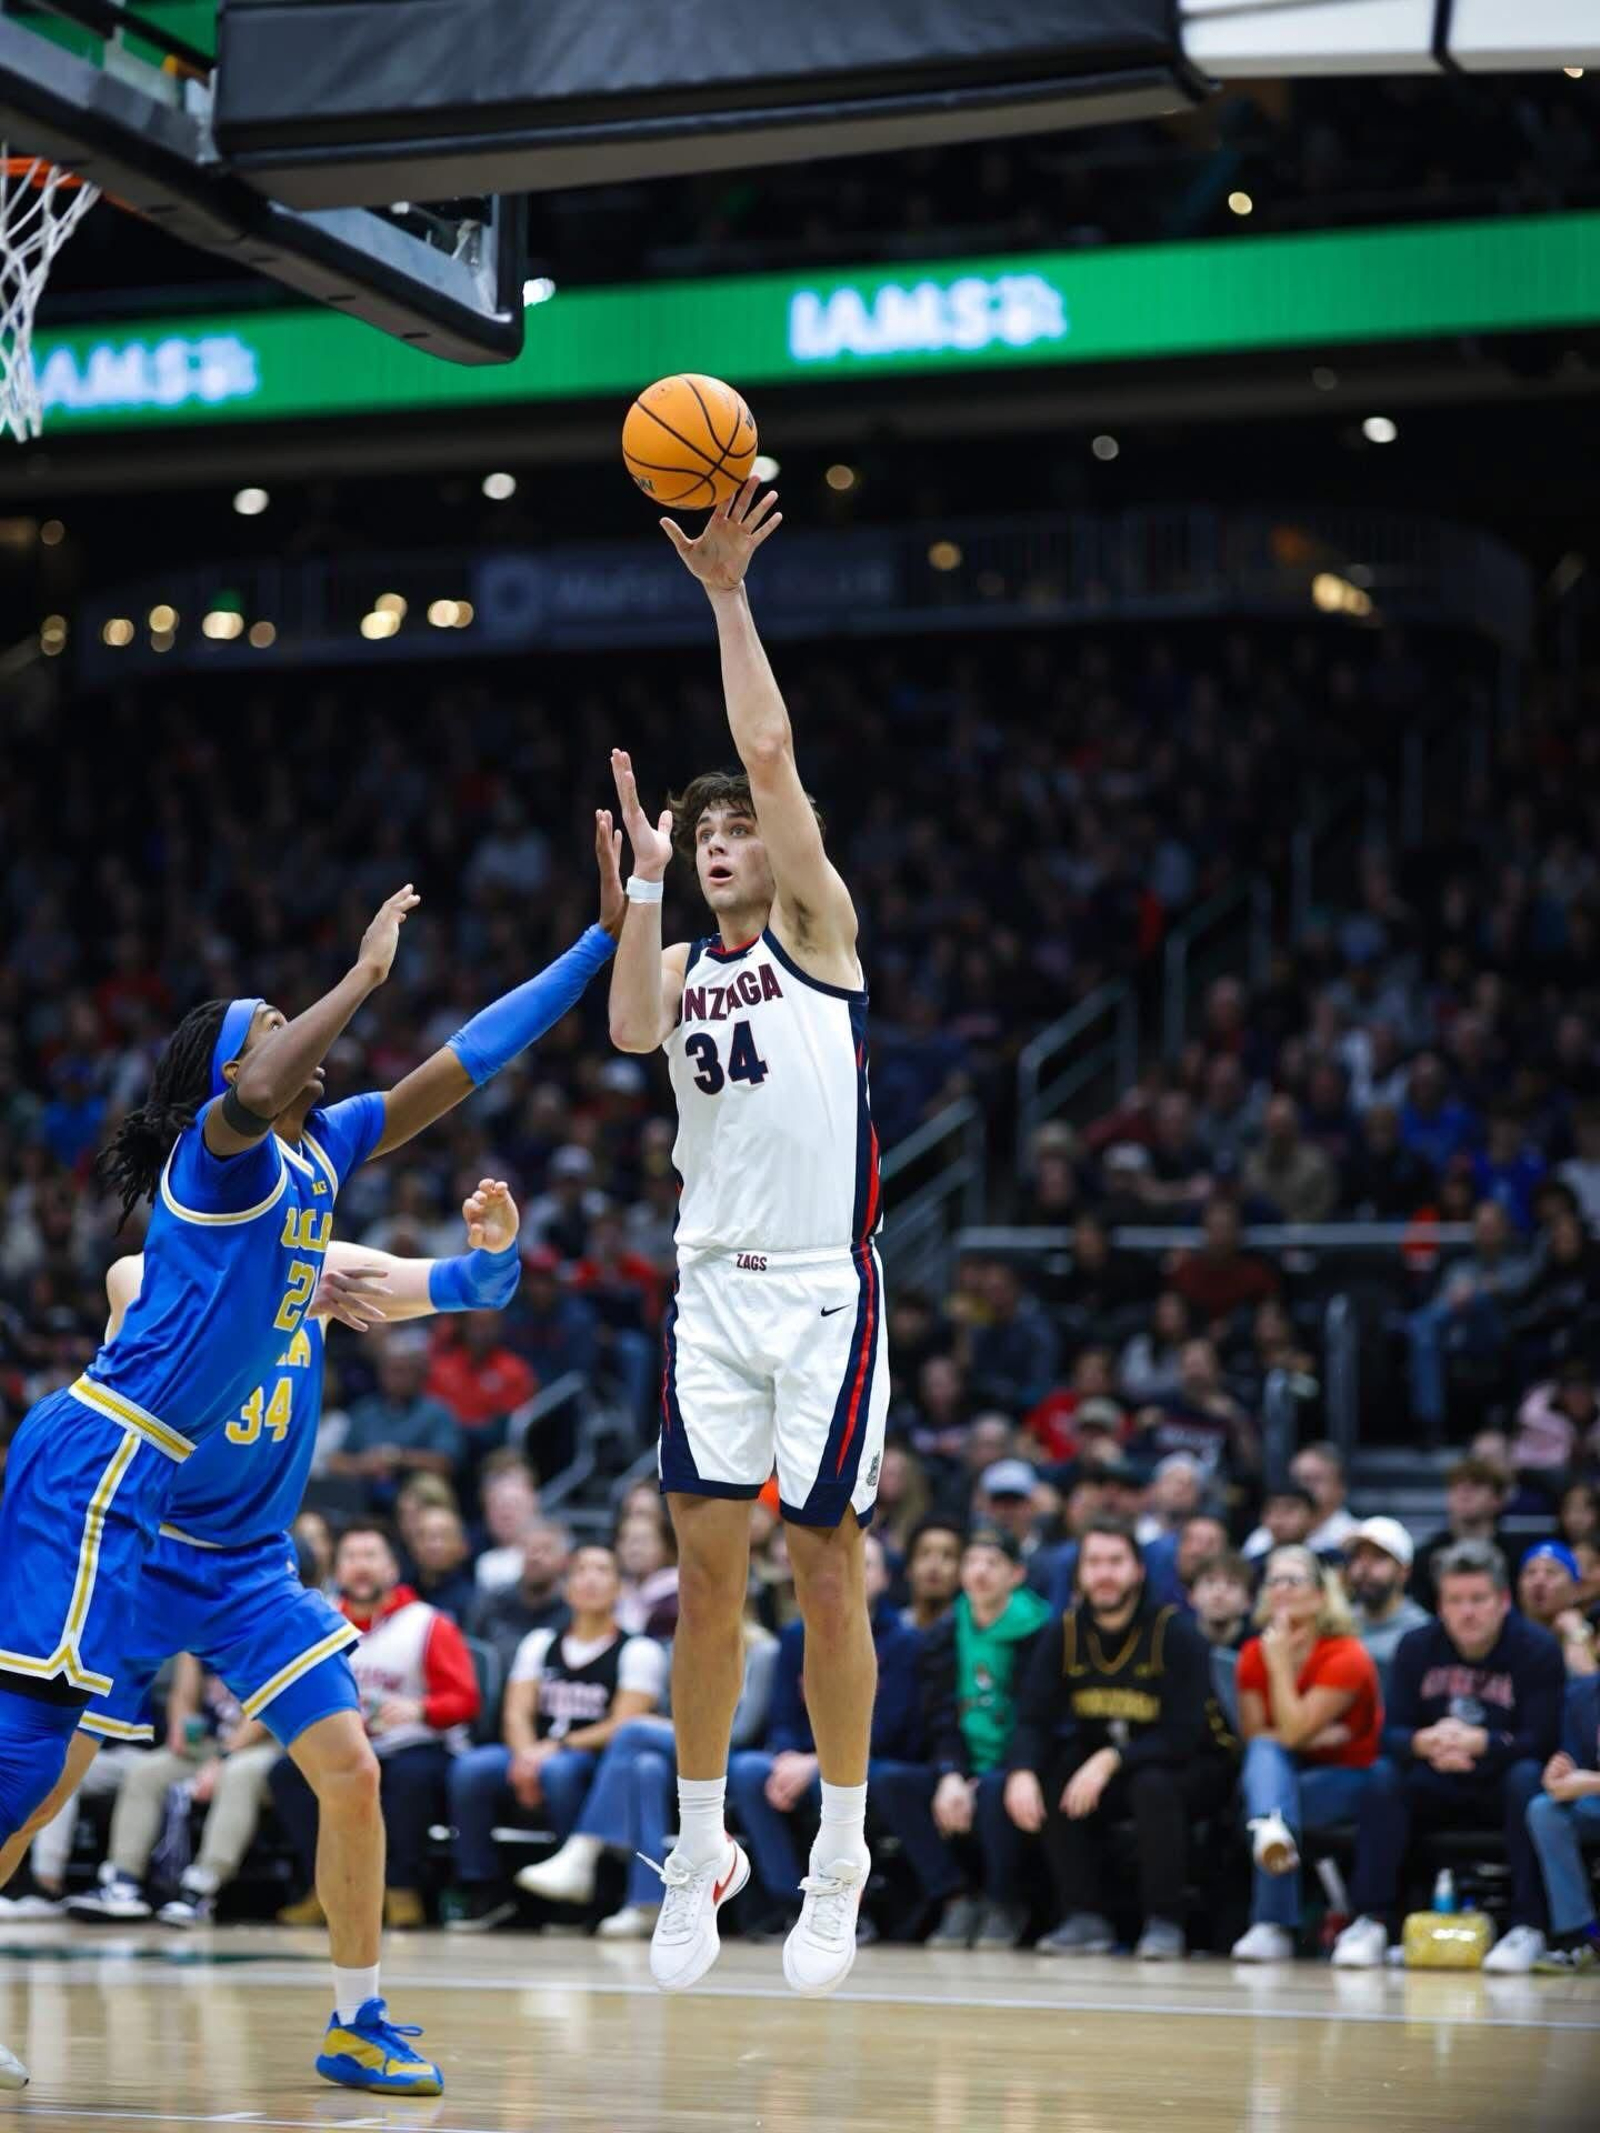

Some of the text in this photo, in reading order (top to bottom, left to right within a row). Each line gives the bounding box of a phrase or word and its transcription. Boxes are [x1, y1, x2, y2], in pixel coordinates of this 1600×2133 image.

[683, 963, 784, 1022] NZAGA
[685, 1020, 769, 1096] 34
[736, 1253, 768, 1272] ZAGS
[225, 1376, 293, 1445] 34
